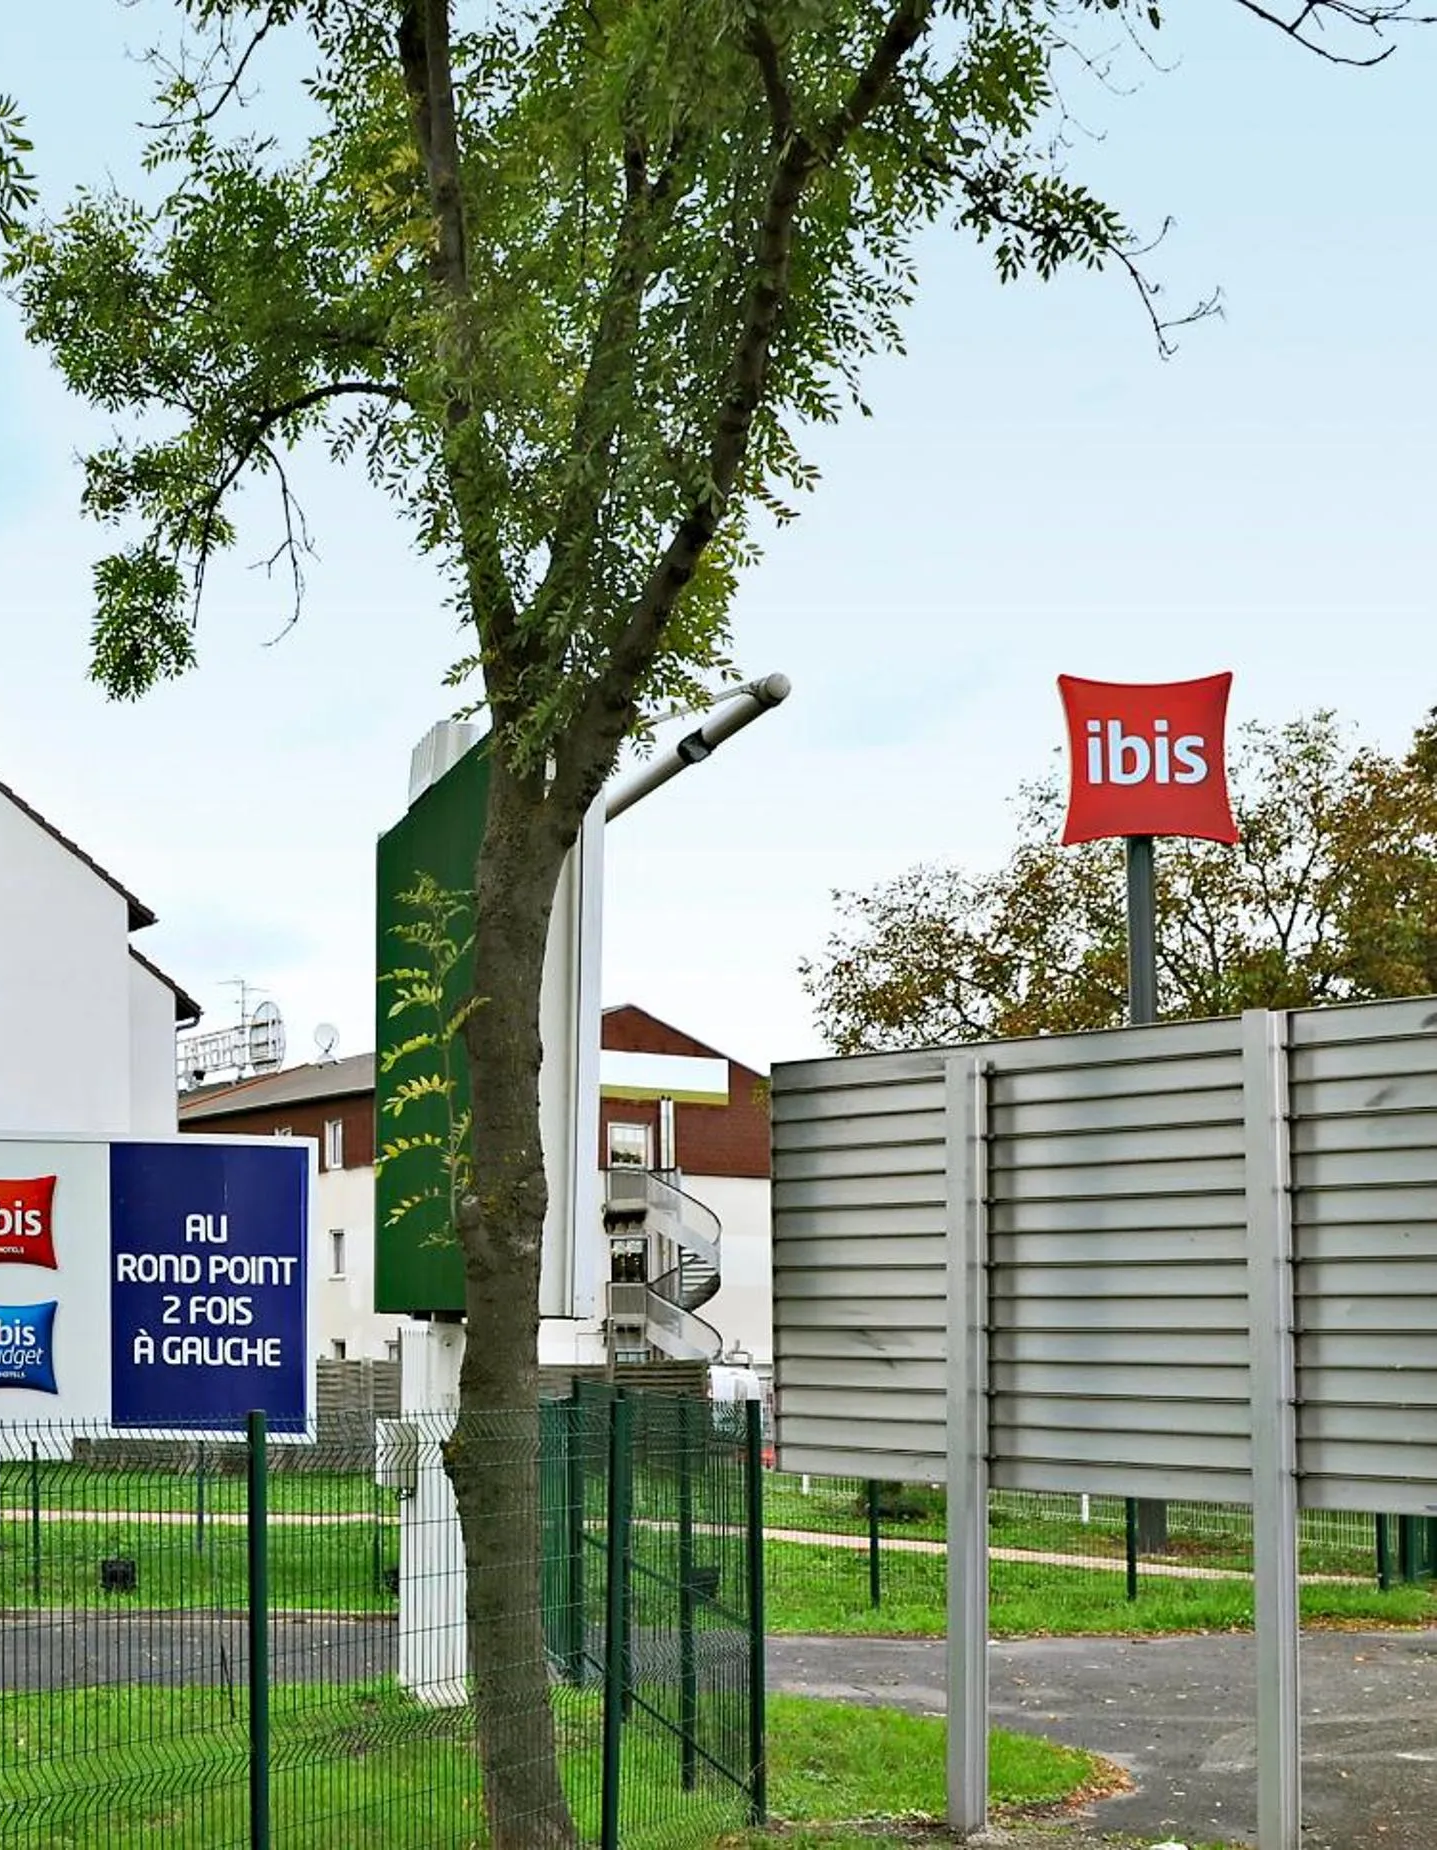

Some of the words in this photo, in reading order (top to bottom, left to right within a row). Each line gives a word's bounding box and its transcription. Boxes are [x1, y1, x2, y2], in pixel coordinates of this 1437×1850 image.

[1086, 719, 1209, 785] ibis
[185, 1213, 228, 1243] AU
[117, 1253, 202, 1284] ROND
[209, 1255, 298, 1286] POINT
[162, 1296, 182, 1324] 2
[189, 1296, 254, 1326] FOIS
[134, 1328, 155, 1365] À
[162, 1336, 282, 1367] GAUCHE
